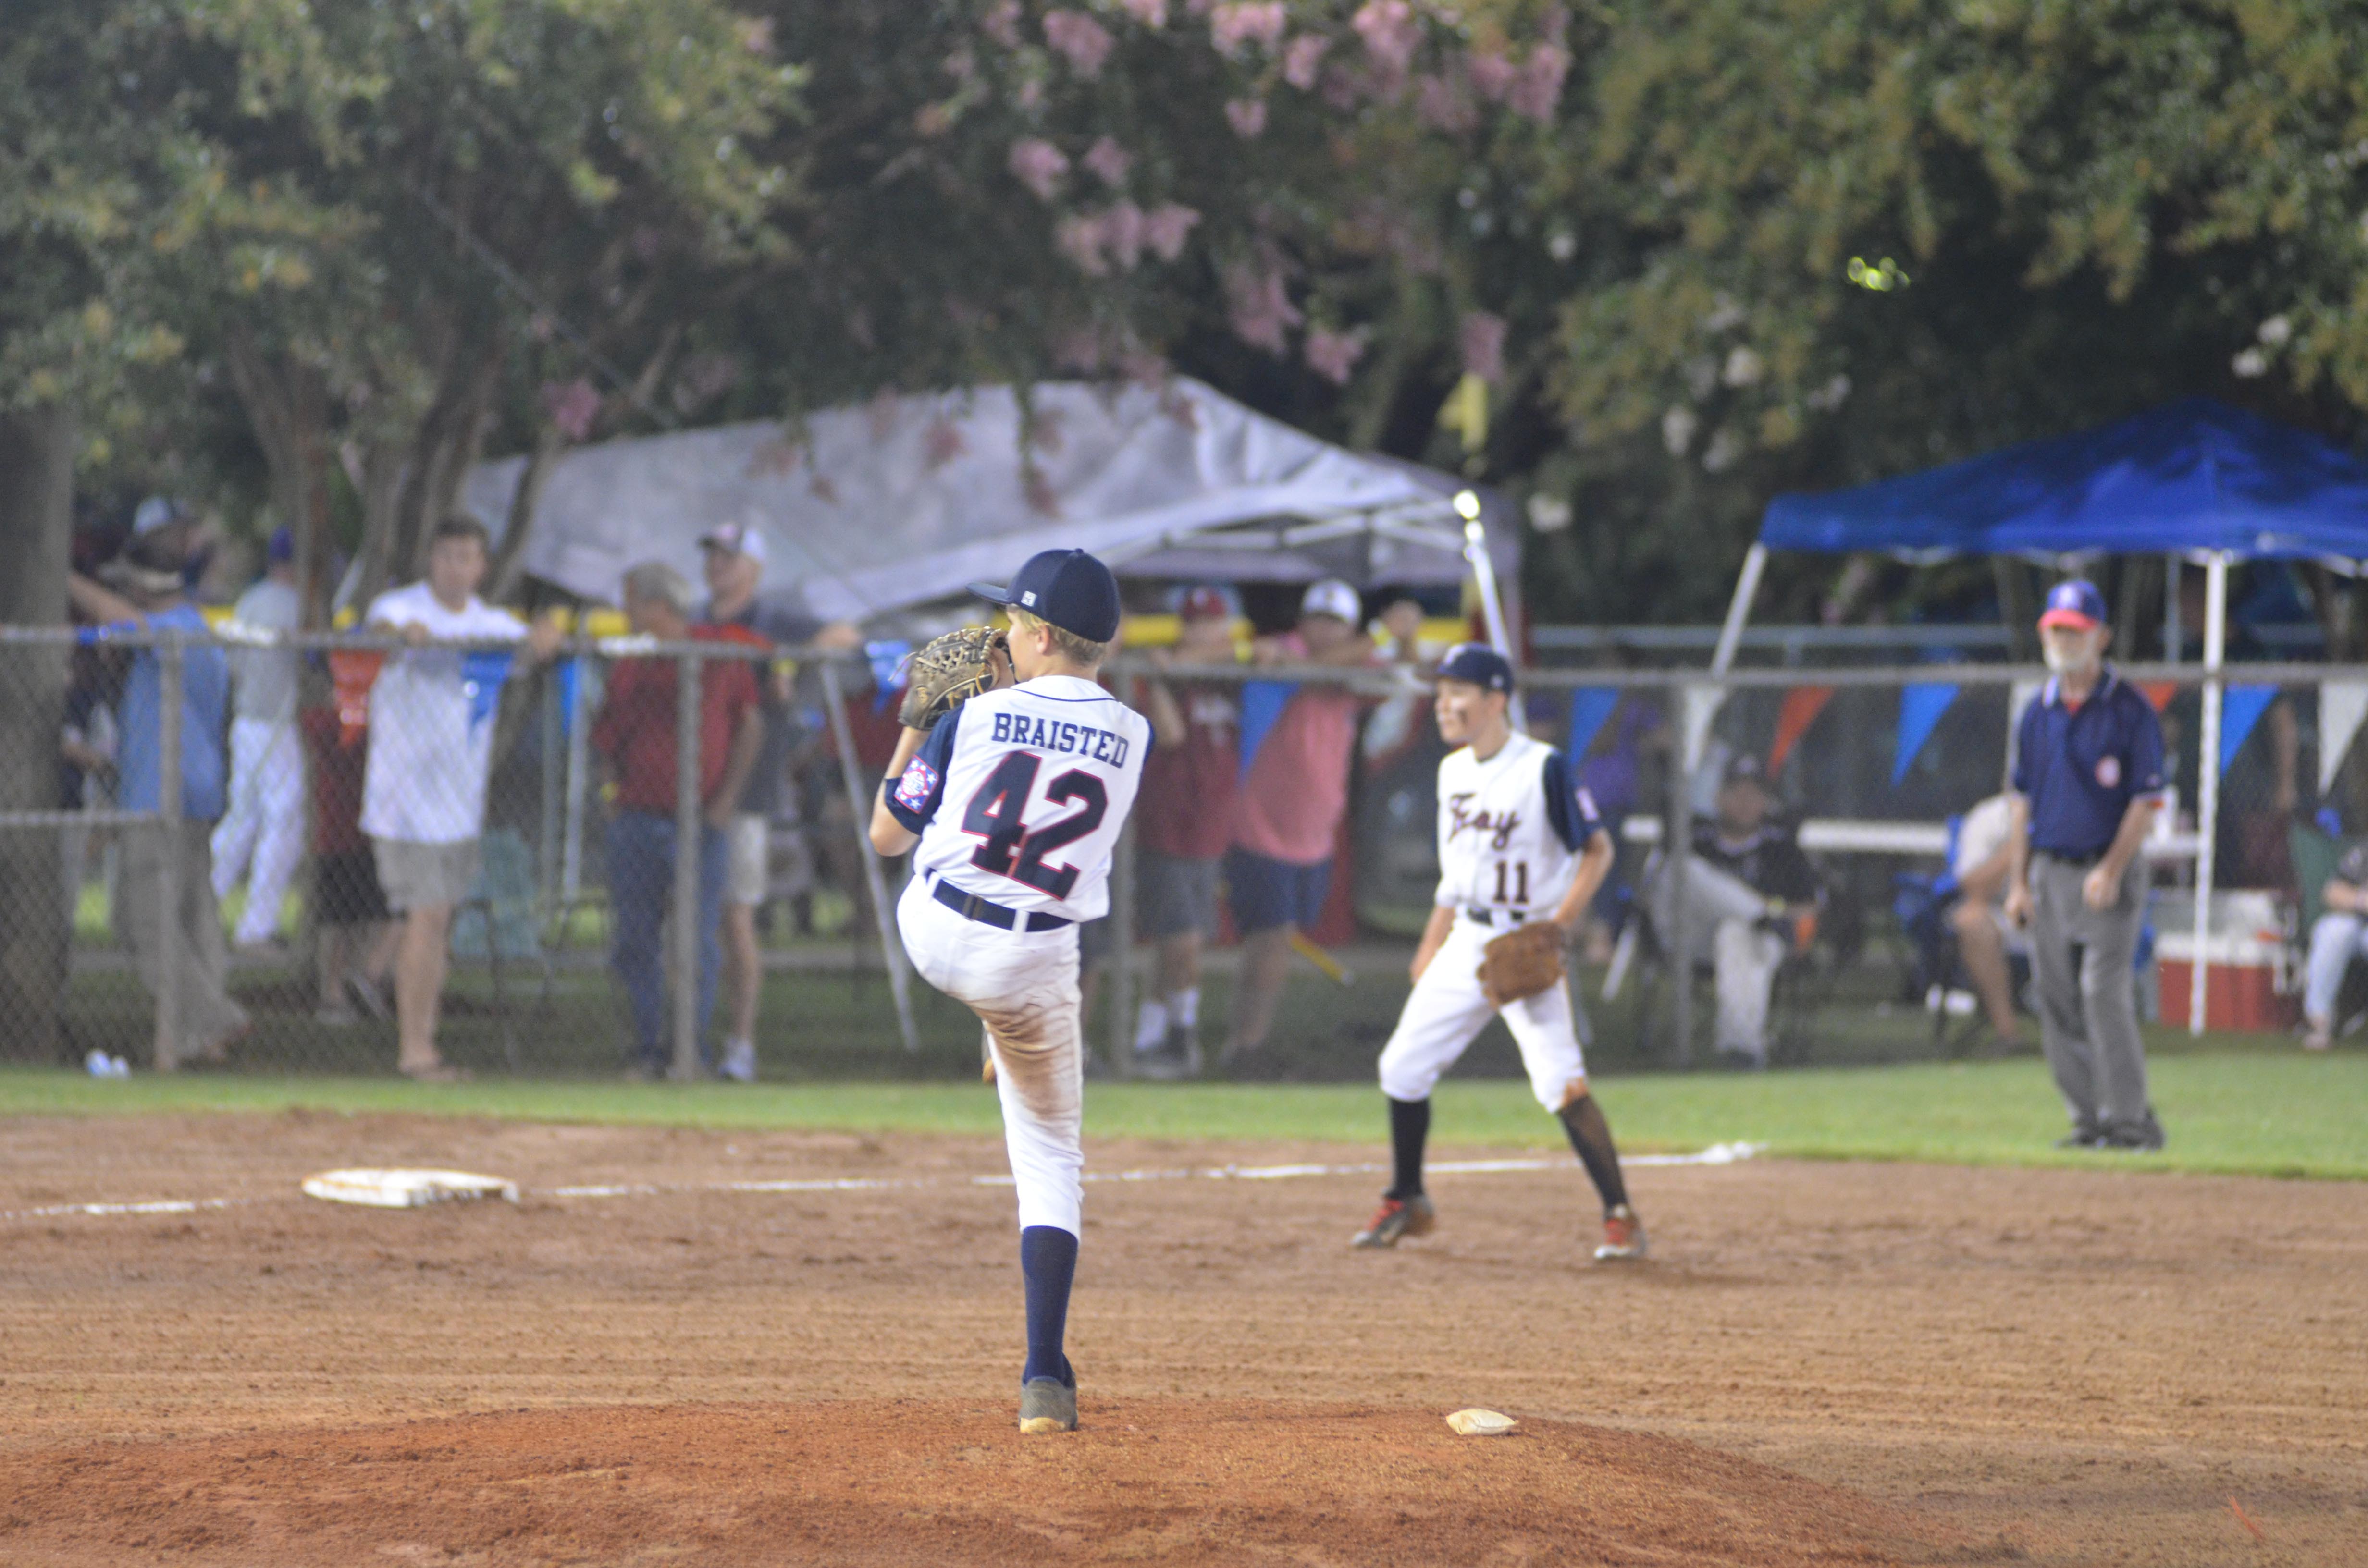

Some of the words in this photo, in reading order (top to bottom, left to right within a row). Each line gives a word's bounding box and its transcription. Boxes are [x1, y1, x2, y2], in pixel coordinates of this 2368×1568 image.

[991, 712, 1129, 769] BRAISTED
[961, 750, 1109, 901] 42
[1492, 860, 1529, 904] 11
